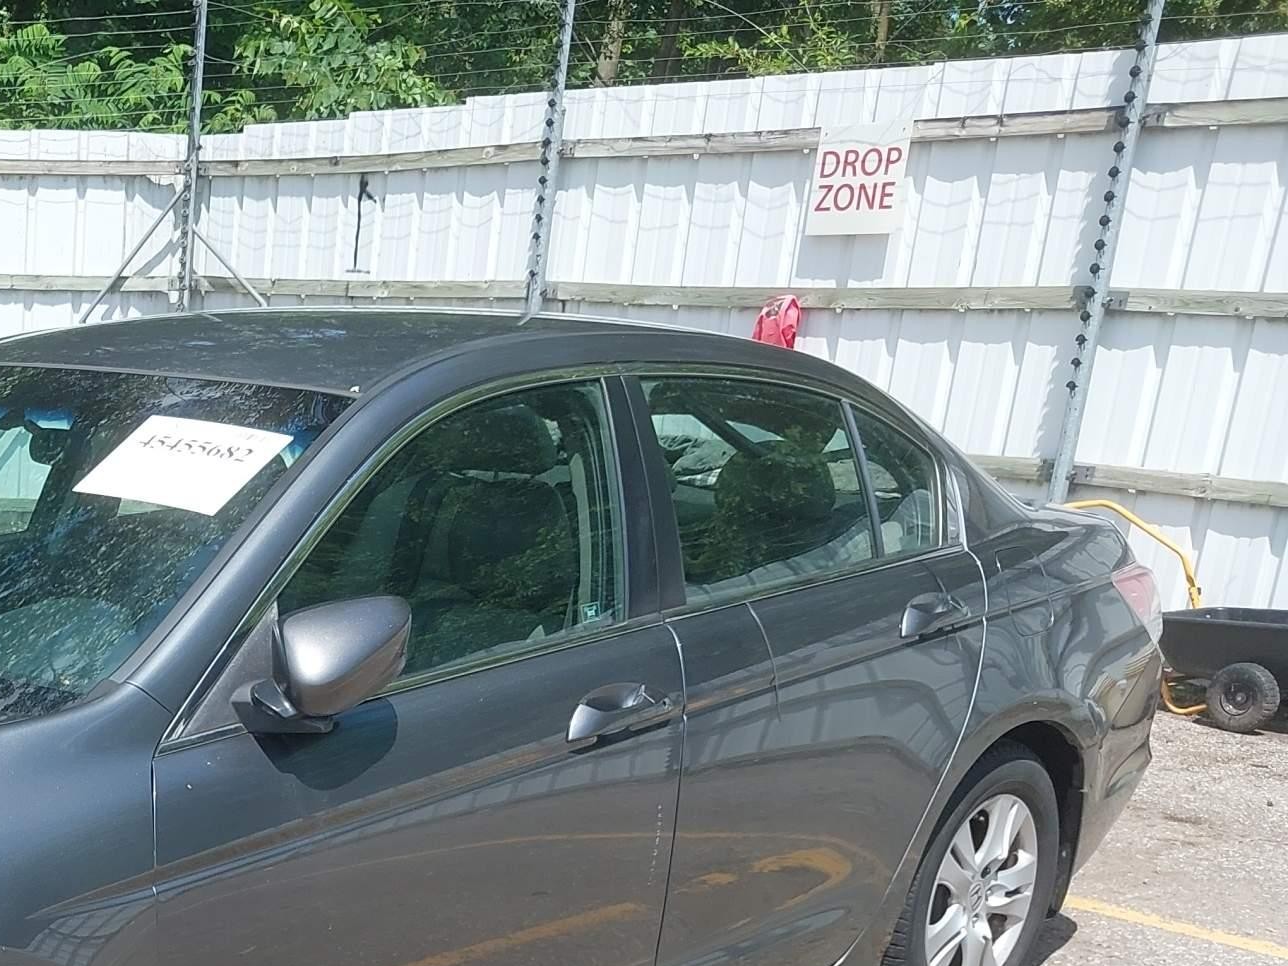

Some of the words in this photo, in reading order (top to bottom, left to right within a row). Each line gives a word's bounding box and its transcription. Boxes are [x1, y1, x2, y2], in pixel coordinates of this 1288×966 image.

[819, 146, 903, 179] DROP
[814, 181, 896, 212] ZONE
[139, 434, 254, 463] 45455682
